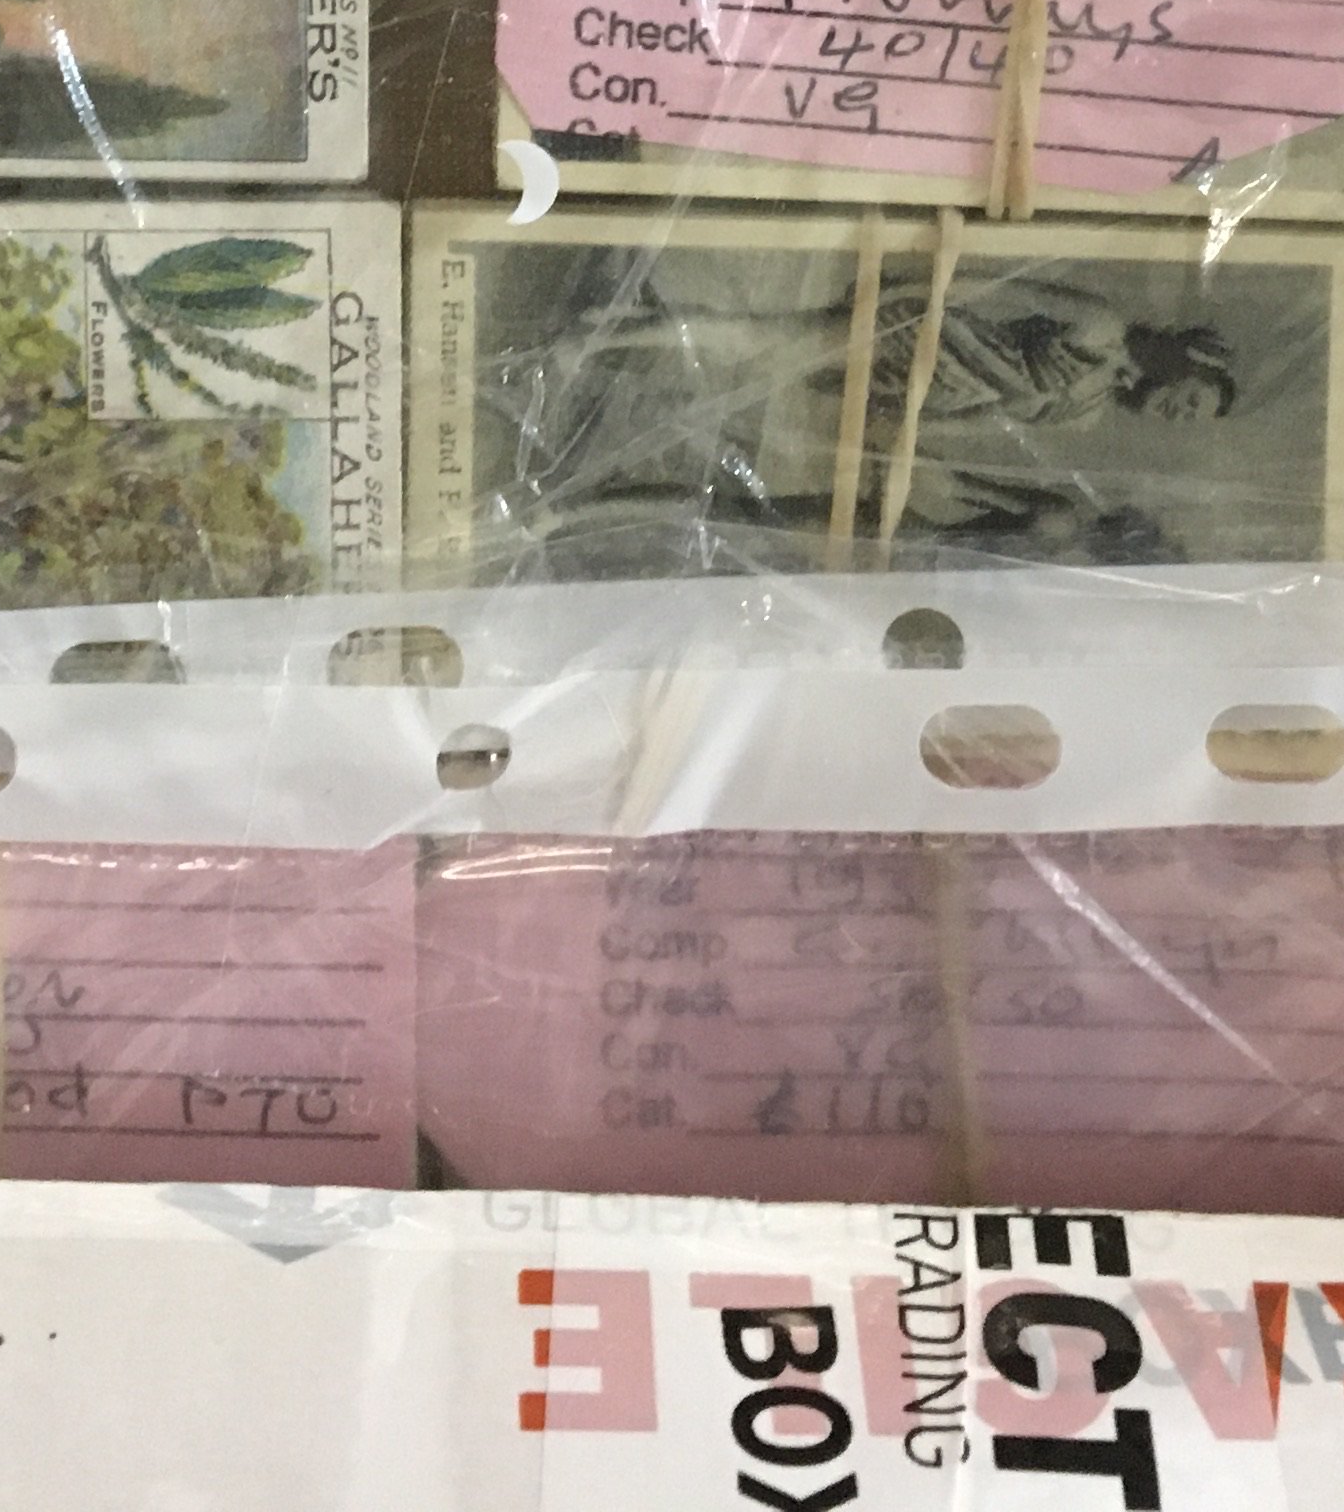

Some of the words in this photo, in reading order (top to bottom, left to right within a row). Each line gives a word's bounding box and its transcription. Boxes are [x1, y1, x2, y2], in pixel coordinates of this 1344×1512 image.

[574, 11, 711, 57] Check
[570, 65, 665, 110] Con.
[88, 298, 107, 415] FLOWERS
[364, 314, 383, 462] WOODLAND
[438, 421, 465, 476] and
